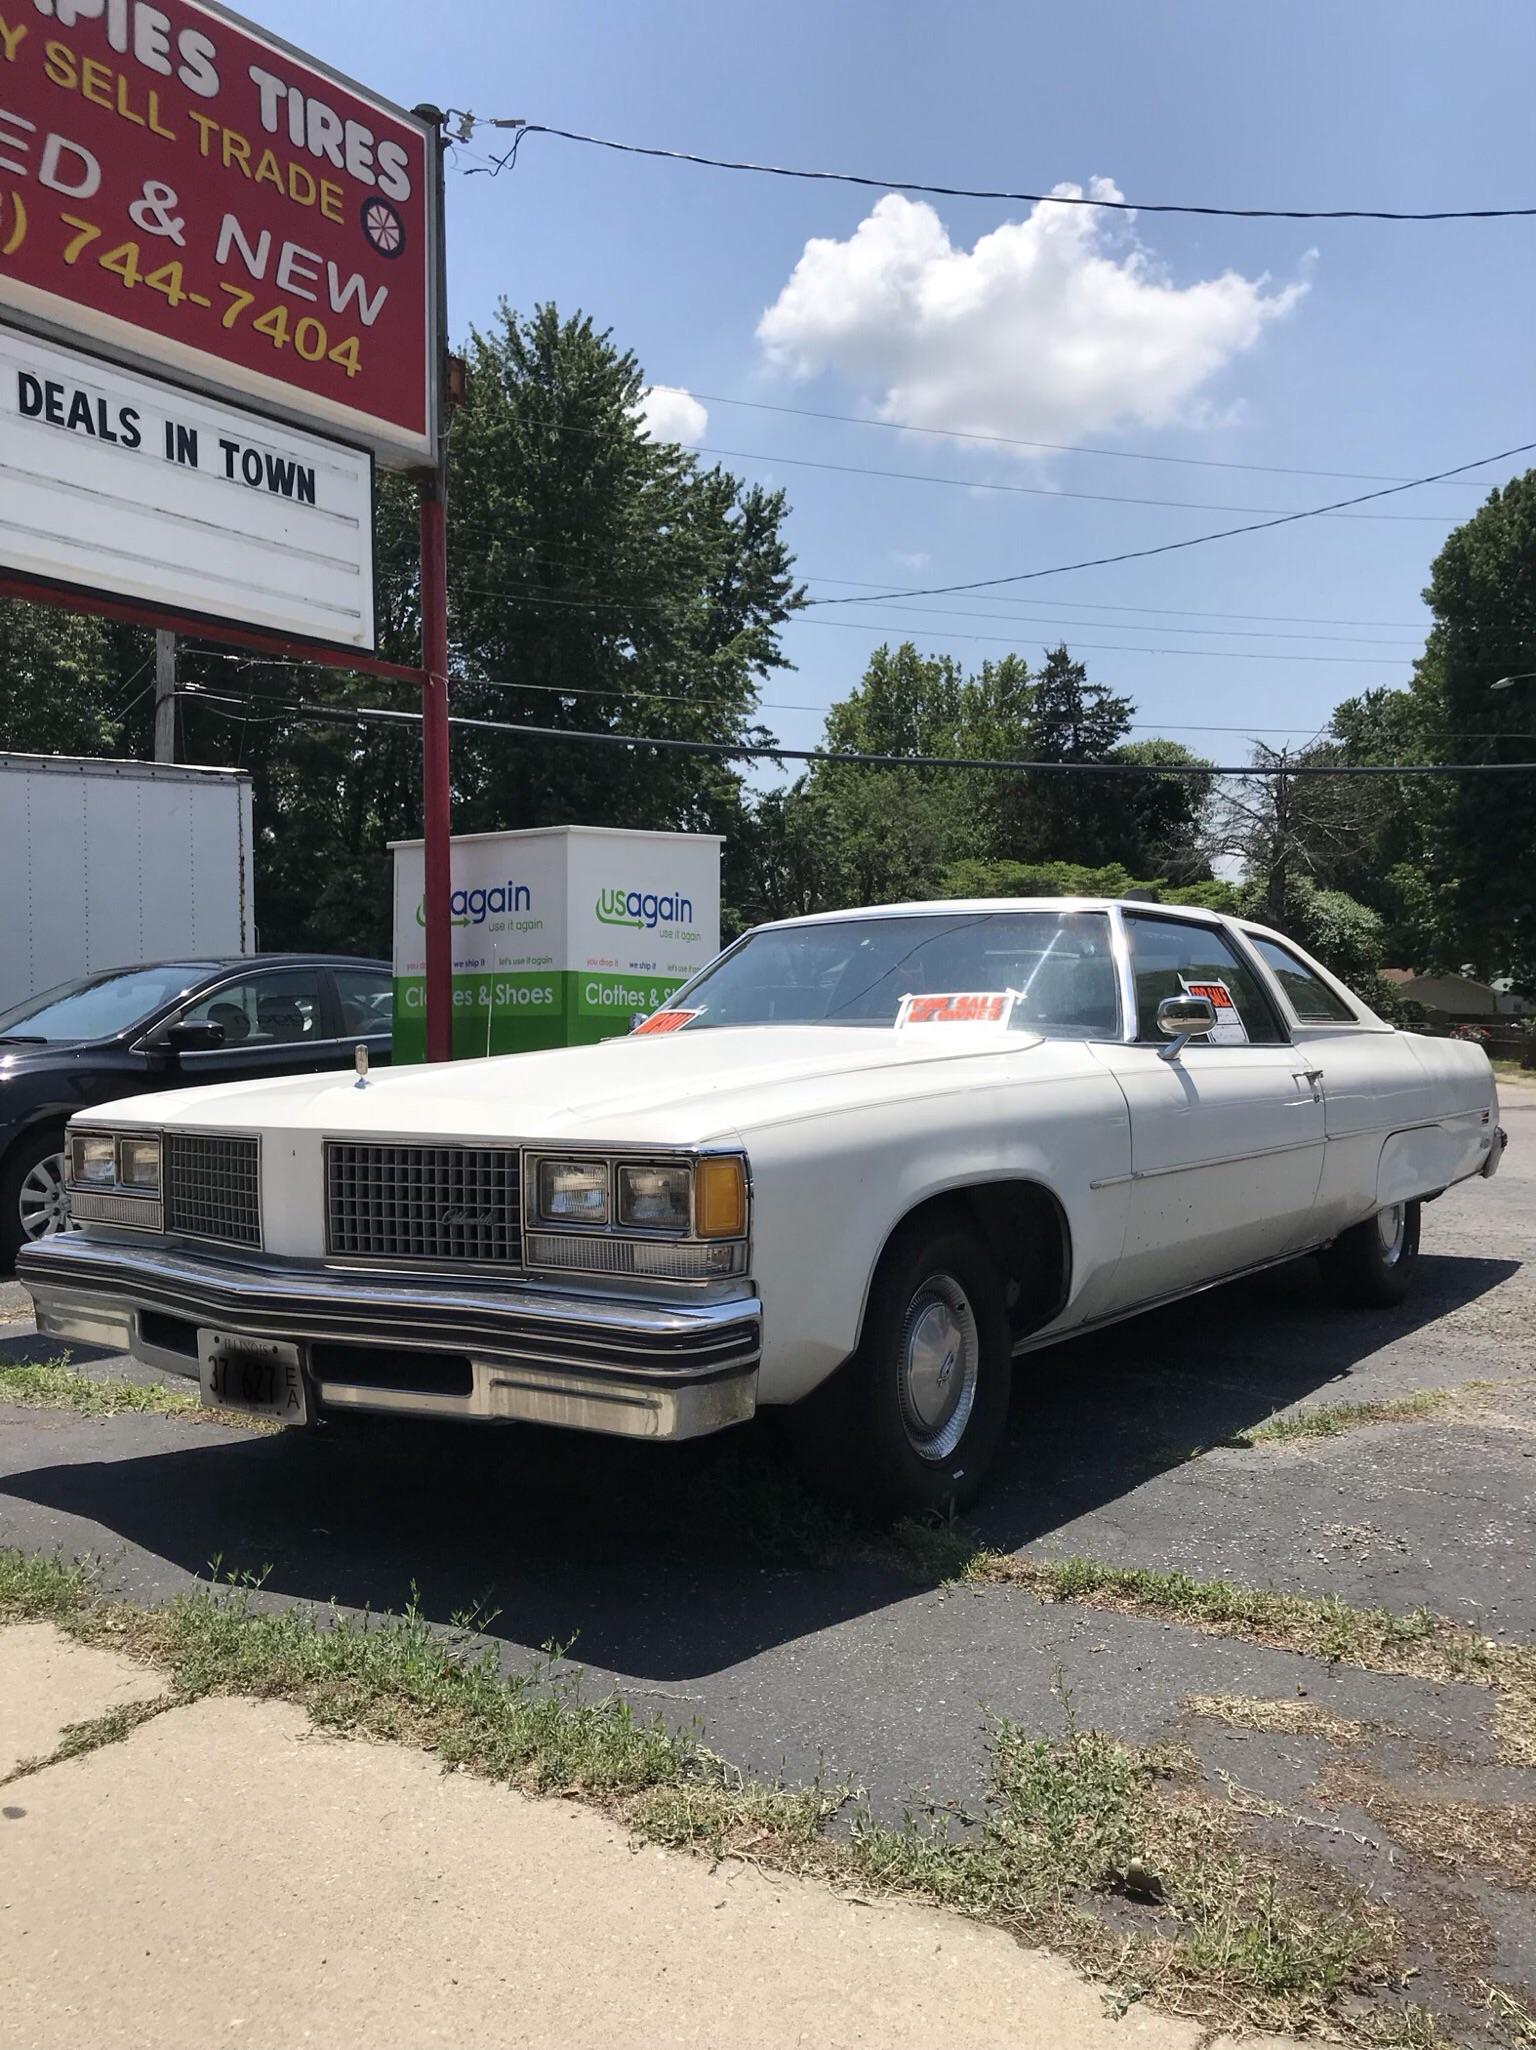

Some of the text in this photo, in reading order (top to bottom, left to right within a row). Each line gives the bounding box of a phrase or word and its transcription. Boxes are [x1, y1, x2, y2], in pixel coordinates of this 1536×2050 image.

[33, 0, 411, 202] IES TIRES
[43, 40, 176, 141] SELL
[188, 110, 345, 225] TRADE
[128, 180, 186, 246] &
[215, 213, 389, 326] NEW
[60, 212, 362, 378] 744-7404
[17, 370, 316, 504] DEALS IN TOWN
[423, 880, 531, 925] again
[600, 888, 693, 928] usagain
[488, 921, 505, 932] use
[516, 918, 543, 933] again
[659, 929, 673, 939] use
[405, 986, 473, 1007] Cles
[496, 984, 553, 1005] Shoes
[585, 983, 645, 1007] Clothes
